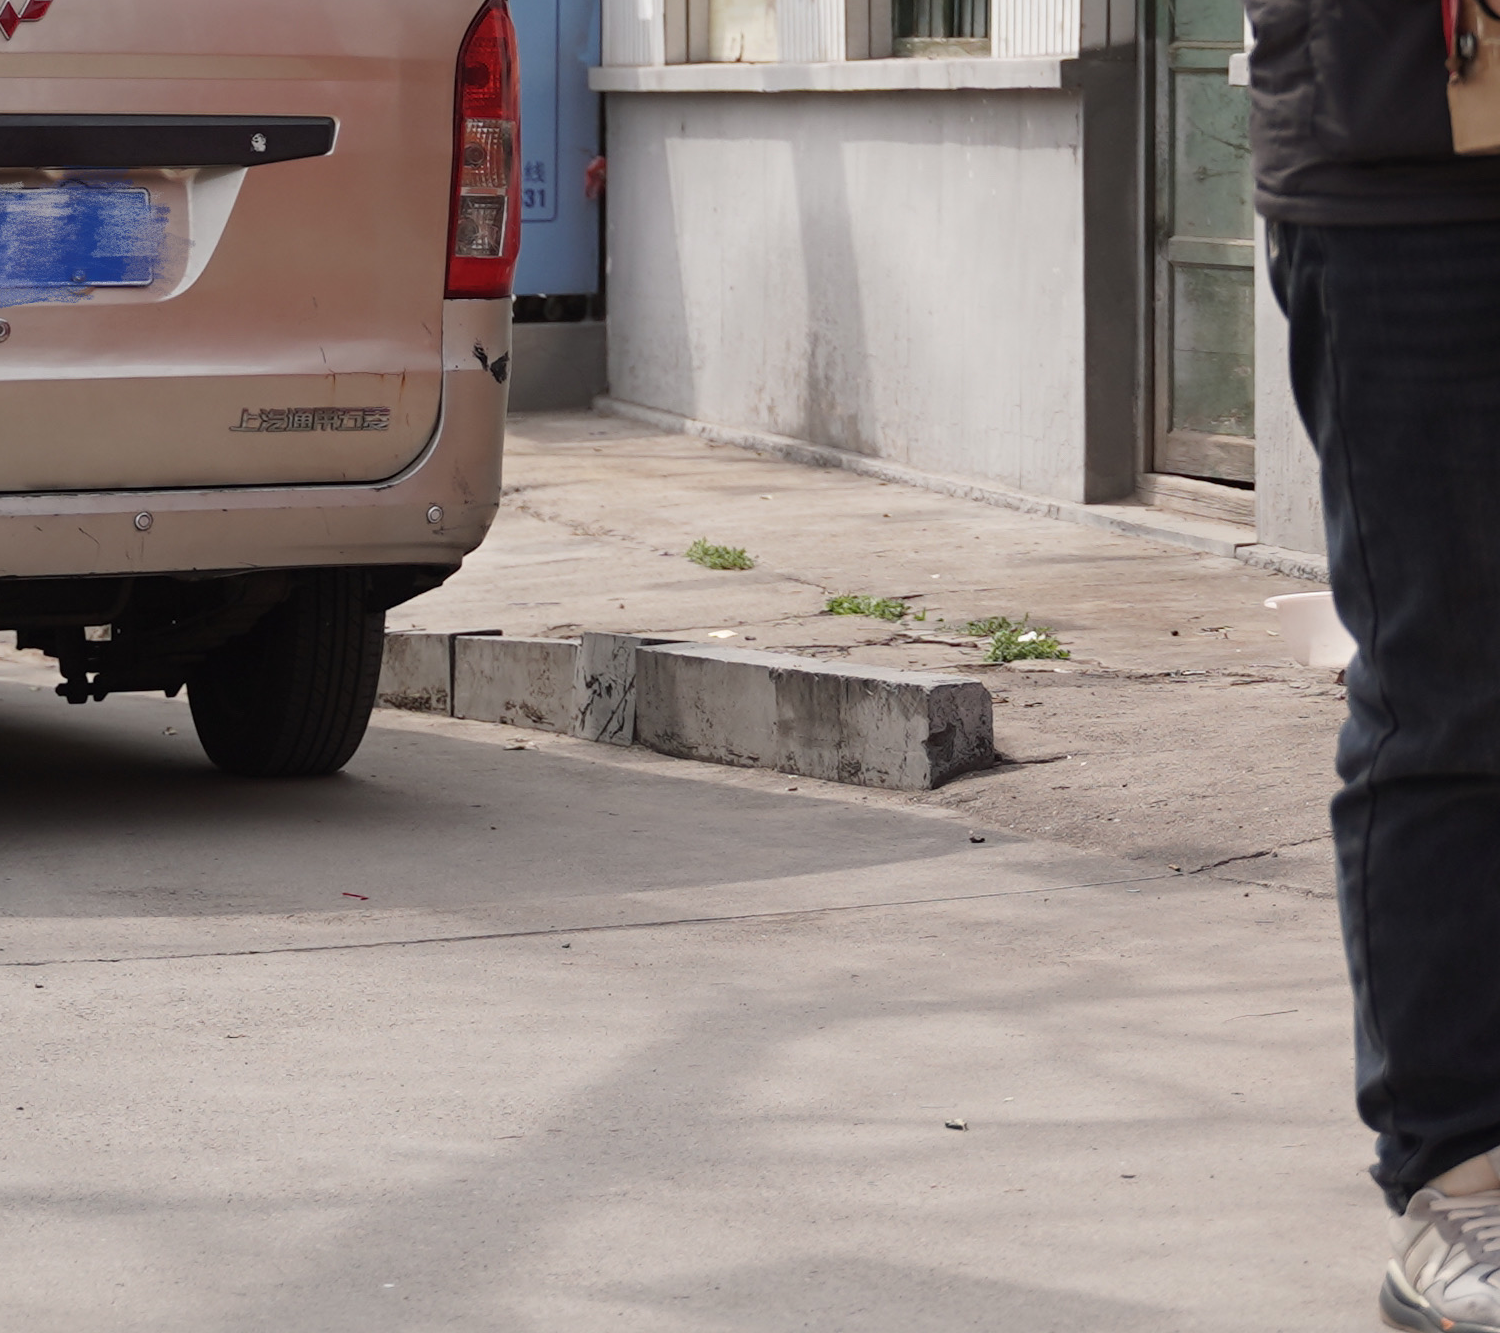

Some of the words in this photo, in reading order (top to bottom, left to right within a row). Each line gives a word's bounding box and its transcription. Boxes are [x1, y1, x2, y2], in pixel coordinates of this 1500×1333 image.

[229, 406, 391, 432] 上汽通用五菱
